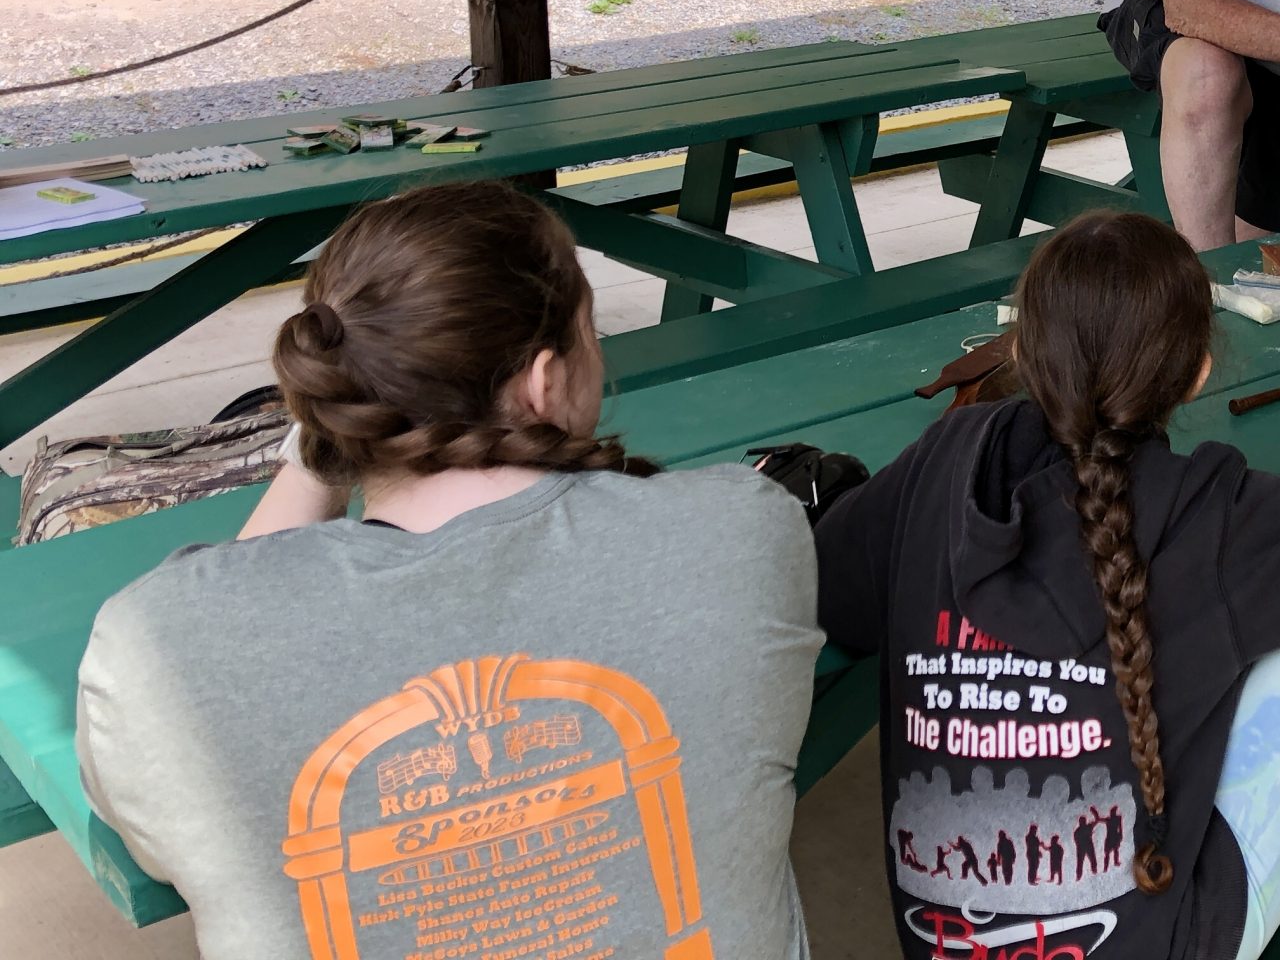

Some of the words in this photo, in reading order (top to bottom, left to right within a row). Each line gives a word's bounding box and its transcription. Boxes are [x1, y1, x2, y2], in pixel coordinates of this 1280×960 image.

[936, 610, 951, 647] A
[906, 653, 947, 676] That
[951, 652, 1053, 680] Inspires
[1058, 658, 1106, 685] You
[923, 683, 953, 710] To
[959, 682, 1021, 712] Rise
[1029, 685, 1068, 714] To
[905, 706, 941, 751] The
[947, 718, 1112, 759] Challenge.
[379, 784, 450, 818] R&B
[456, 751, 593, 798] PRODUCTIONS
[392, 784, 597, 855] Sponsors
[378, 890, 417, 906] Lisa
[421, 872, 488, 896] Becker
[492, 851, 561, 877] Custom
[565, 828, 618, 854] Cakes
[448, 887, 495, 907] State
[498, 871, 548, 893] Farm
[551, 837, 641, 876] Insurance
[417, 906, 484, 930] Shanes
[489, 893, 530, 913] Auto
[534, 870, 595, 899] Repair
[482, 927, 533, 949] Lawn
[554, 895, 618, 925] Garden
[416, 927, 467, 948] Milky
[472, 916, 511, 934] Way
[558, 916, 609, 941] Home
